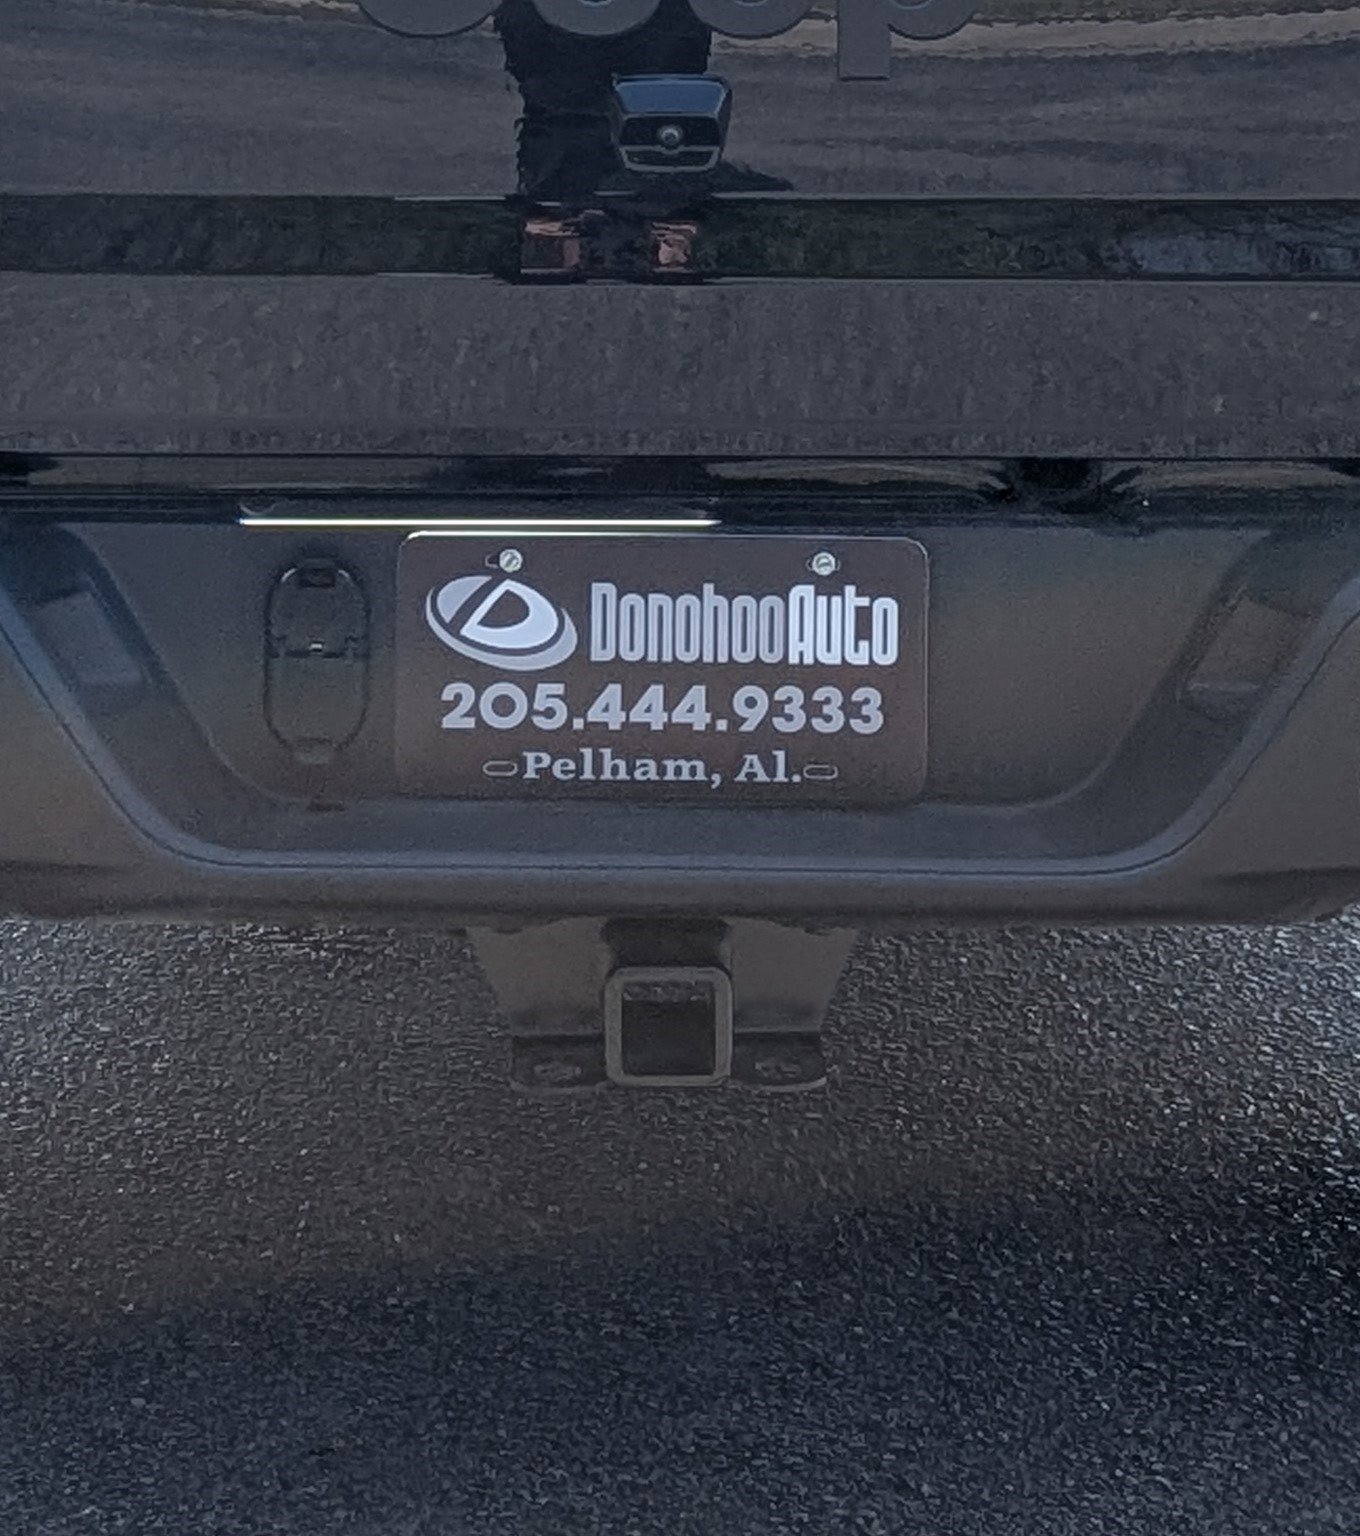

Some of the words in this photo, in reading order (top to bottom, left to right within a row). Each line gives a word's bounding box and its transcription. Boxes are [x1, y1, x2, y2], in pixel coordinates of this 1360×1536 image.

[590, 582, 899, 665] DonohooAuto
[440, 682, 884, 734] 205.444.9333
[522, 748, 722, 789] Pelham,
[735, 750, 801, 783] Al.
